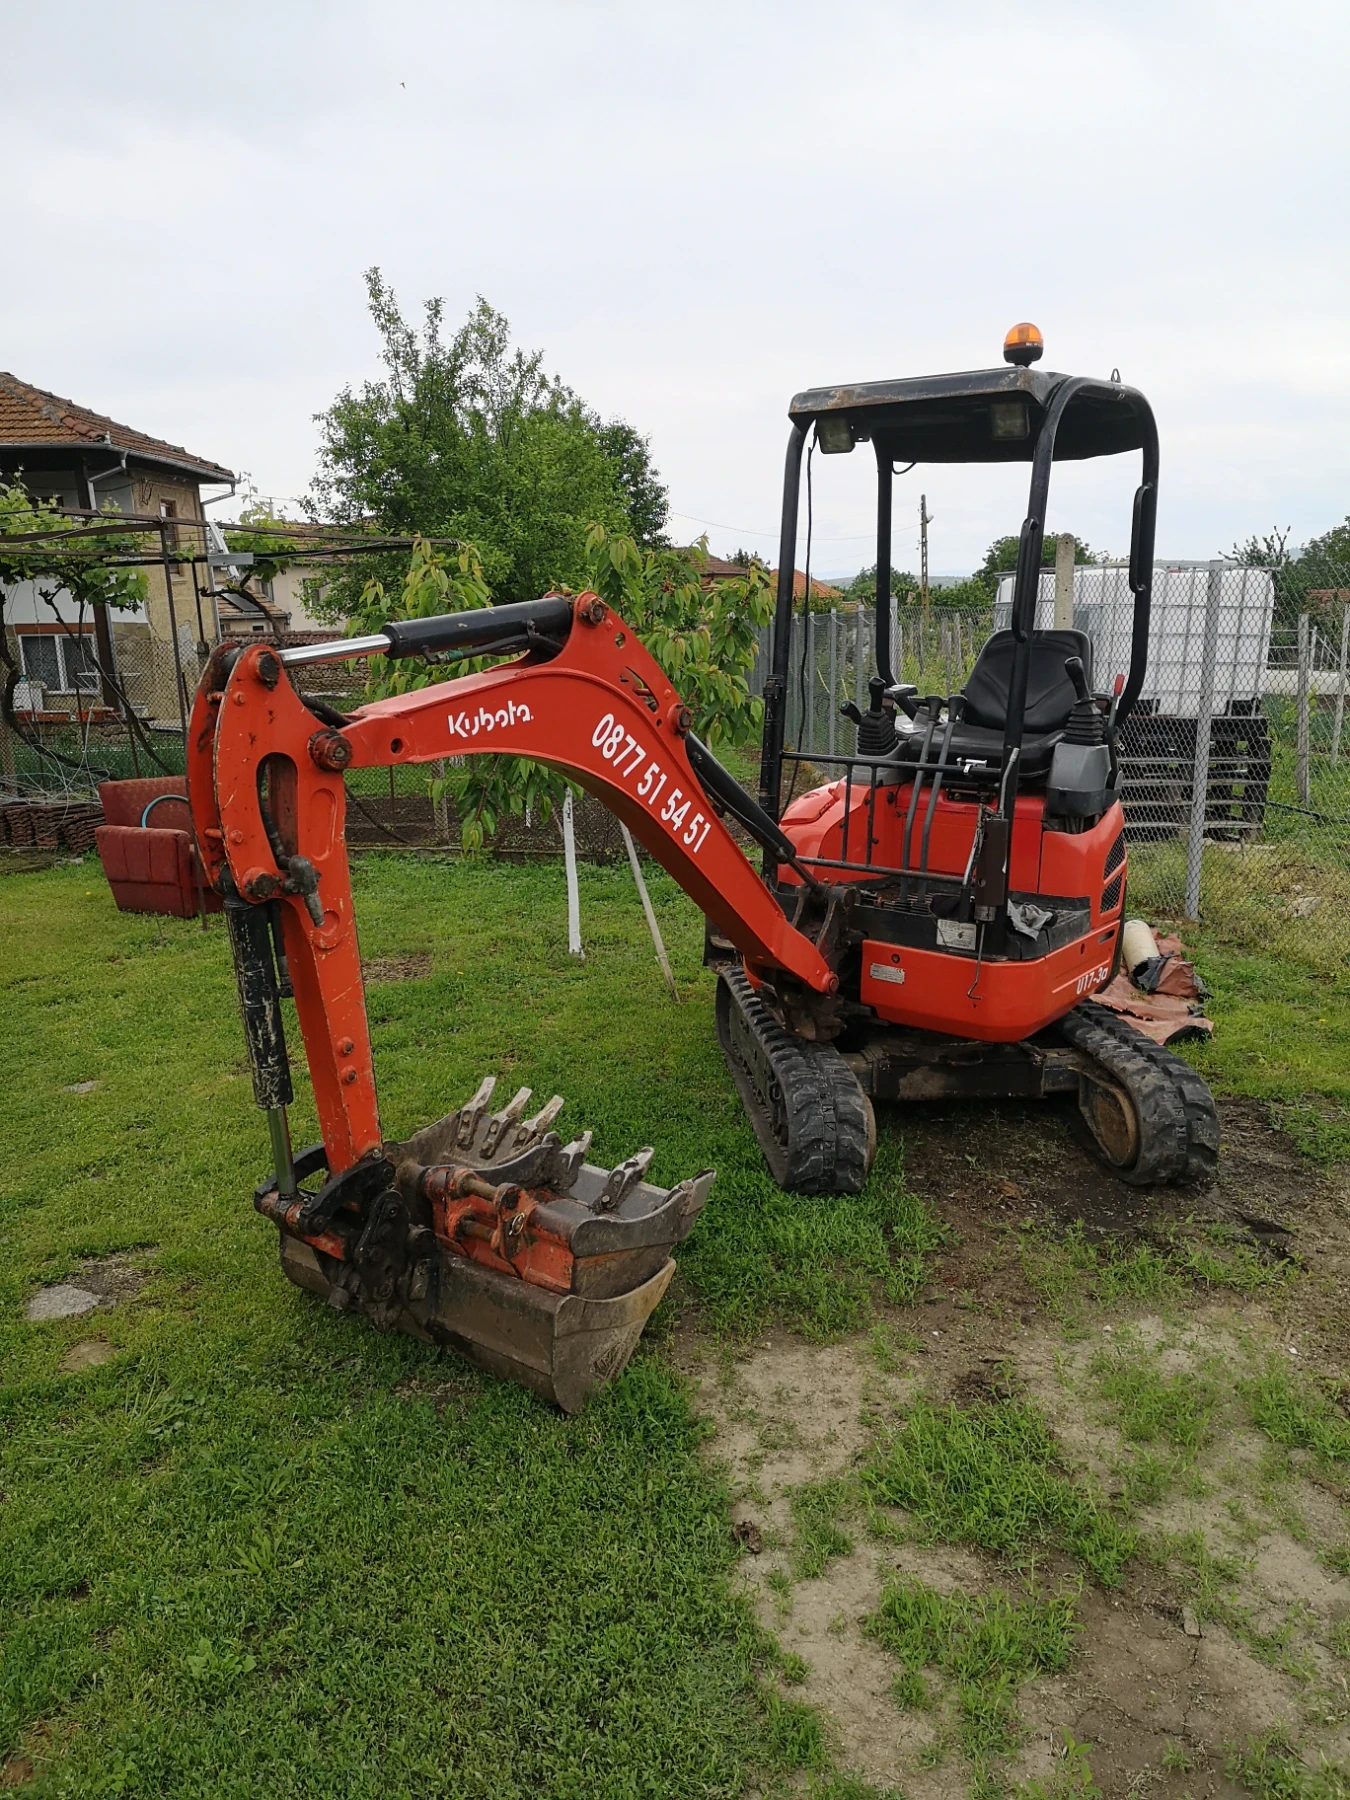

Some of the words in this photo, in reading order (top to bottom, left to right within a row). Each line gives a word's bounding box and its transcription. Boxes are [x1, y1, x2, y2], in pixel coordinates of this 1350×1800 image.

[447, 700, 533, 738] Kubota
[591, 713, 646, 777] 0877
[637, 762, 667, 805] 51
[661, 788, 692, 831] 54
[683, 813, 711, 853] 51
